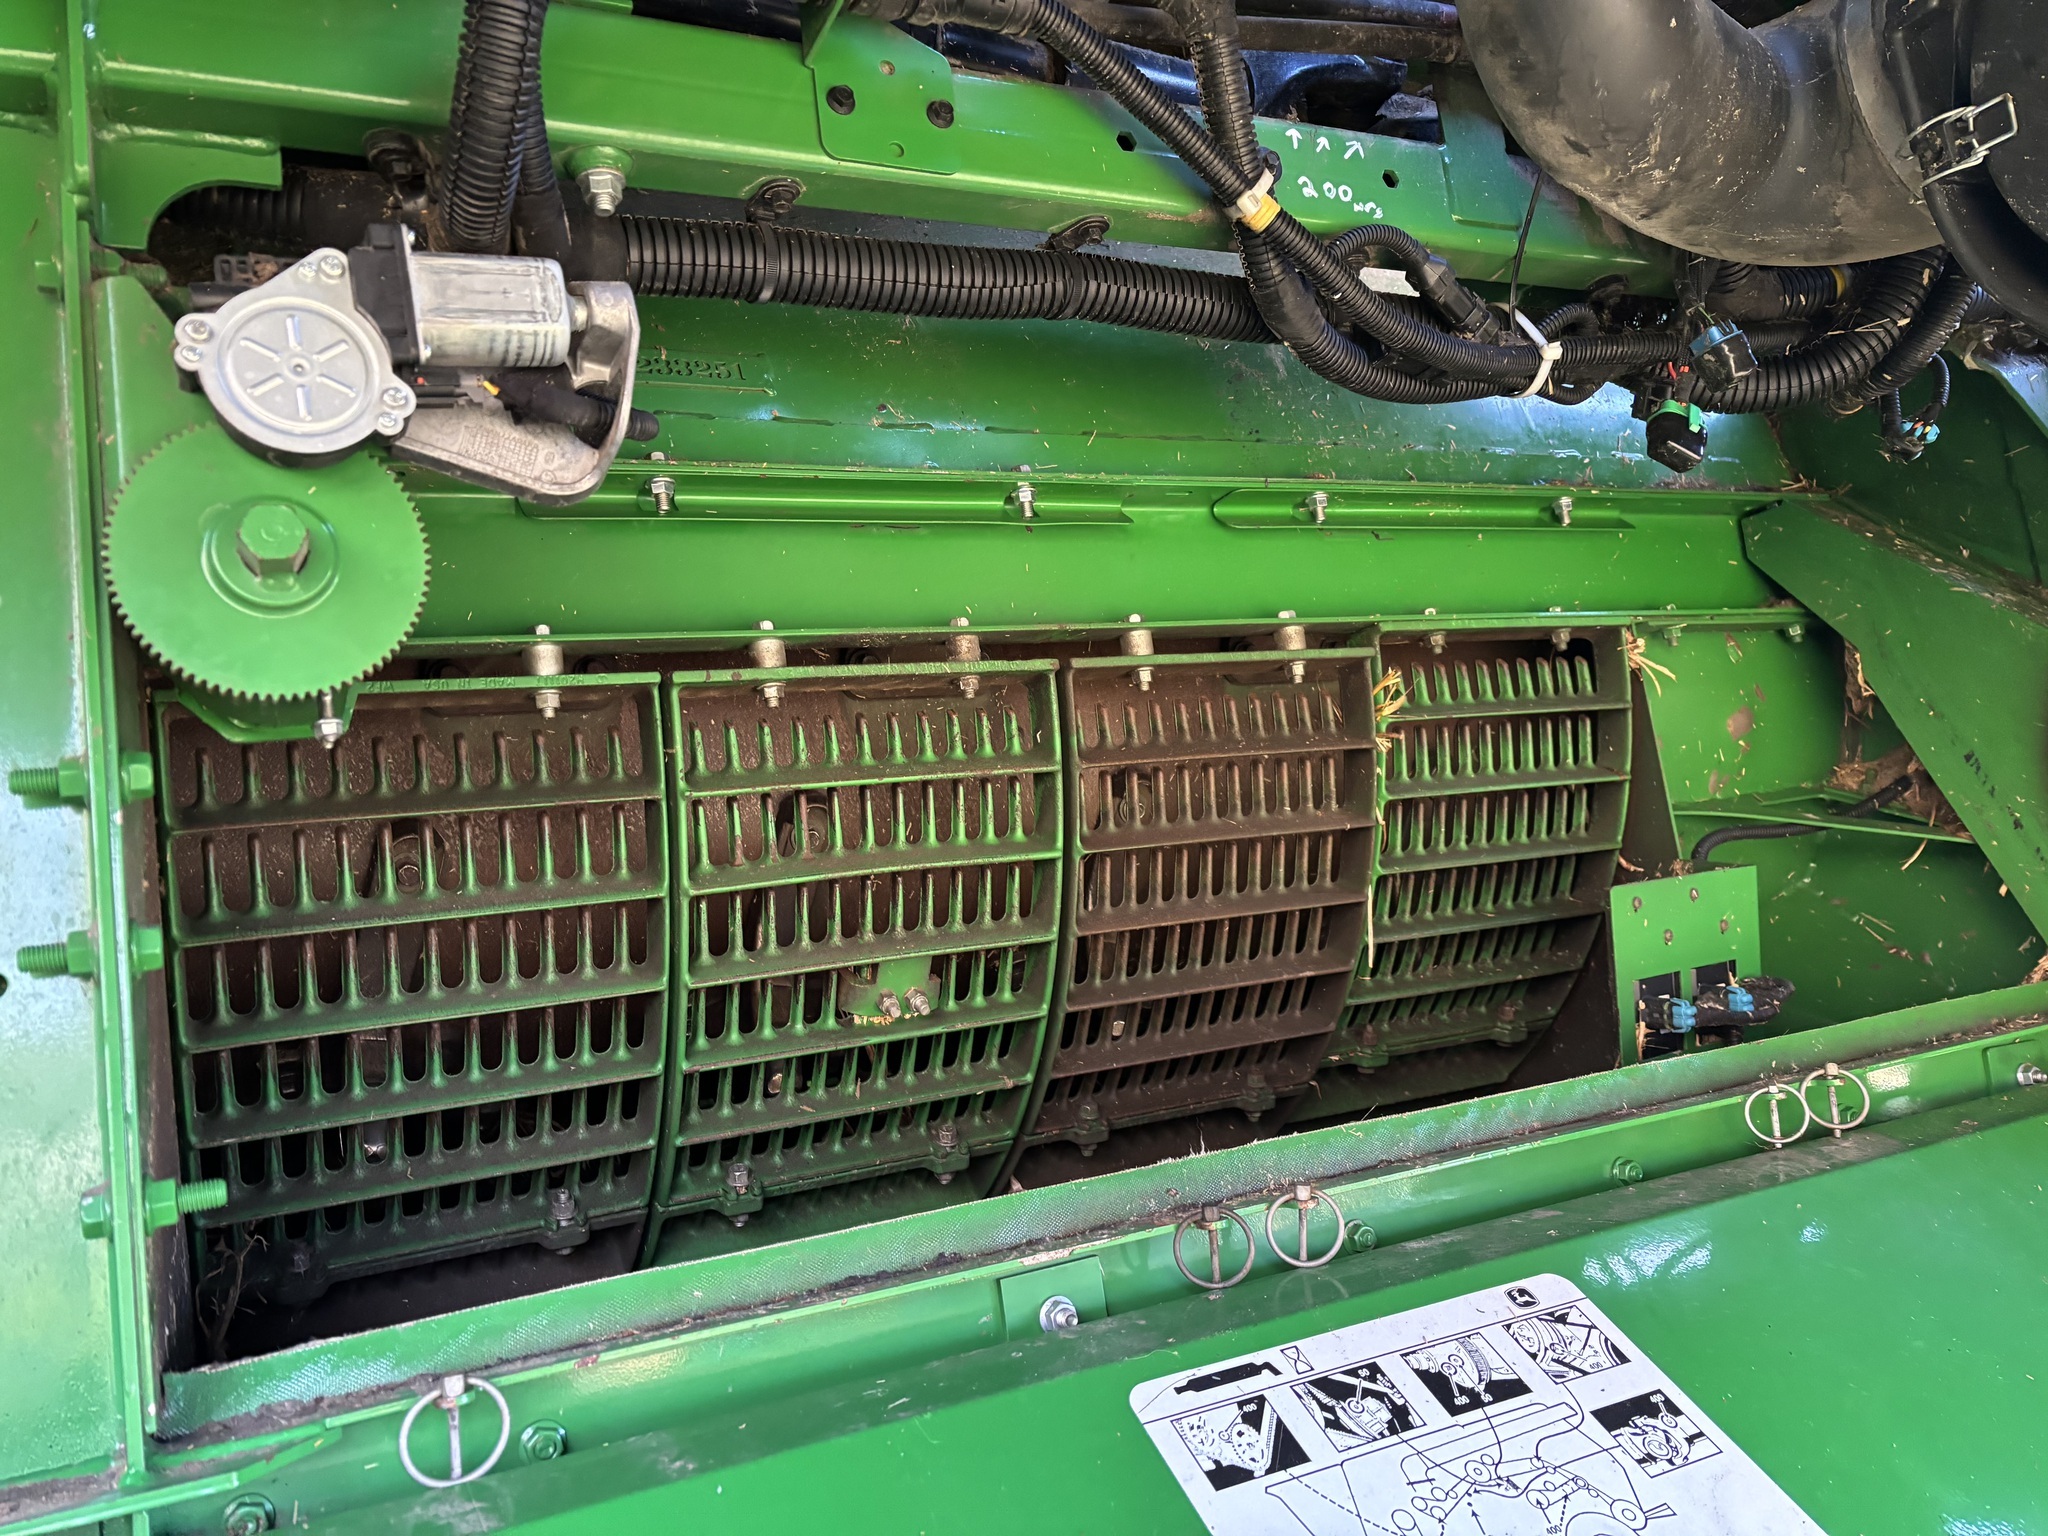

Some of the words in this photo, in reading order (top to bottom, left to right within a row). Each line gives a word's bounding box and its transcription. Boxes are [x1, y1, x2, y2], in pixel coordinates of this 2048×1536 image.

[1297, 176, 1353, 202] 200
[480, 677, 516, 688] MADE
[1588, 1361, 1604, 1370] 400
[1453, 1395, 1470, 1406] 400
[1649, 1393, 1665, 1403] 400
[1242, 1402, 1258, 1413] 400
